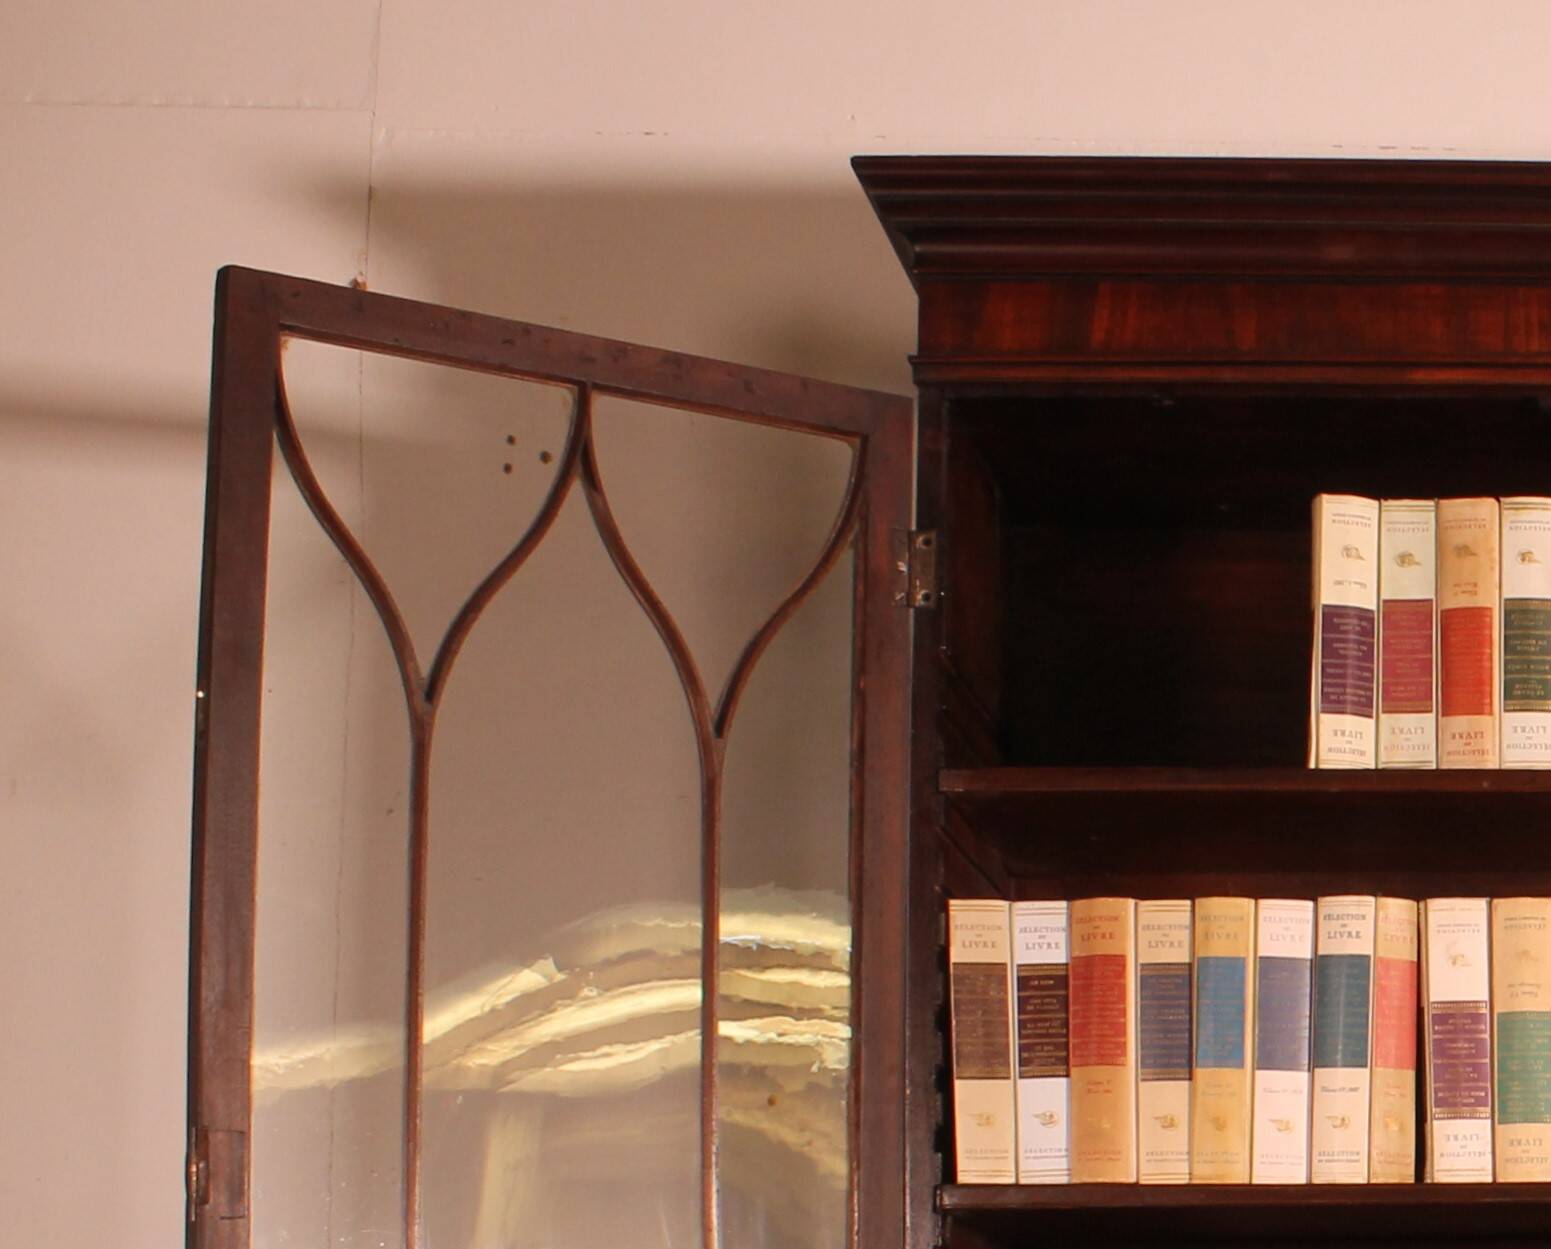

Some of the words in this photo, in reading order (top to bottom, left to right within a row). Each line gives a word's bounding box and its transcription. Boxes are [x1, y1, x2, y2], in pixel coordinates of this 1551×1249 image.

[1332, 729, 1363, 739] LIVRE
[1390, 726, 1424, 735] LIVRE
[1512, 726, 1546, 734] LIVRE
[1451, 731, 1484, 740] LIVRE
[1323, 912, 1366, 921] SÉLECTION
[1080, 931, 1115, 941] LIVRE
[1270, 933, 1305, 943] LIVRE
[1327, 930, 1362, 940] LIVRE
[962, 940, 998, 949] LIVRE
[1025, 941, 1061, 950] LIVRE
[1147, 940, 1185, 949] LIVRE
[1444, 1134, 1480, 1142] LIVRE
[1508, 1138, 1543, 1147] LIVRE
